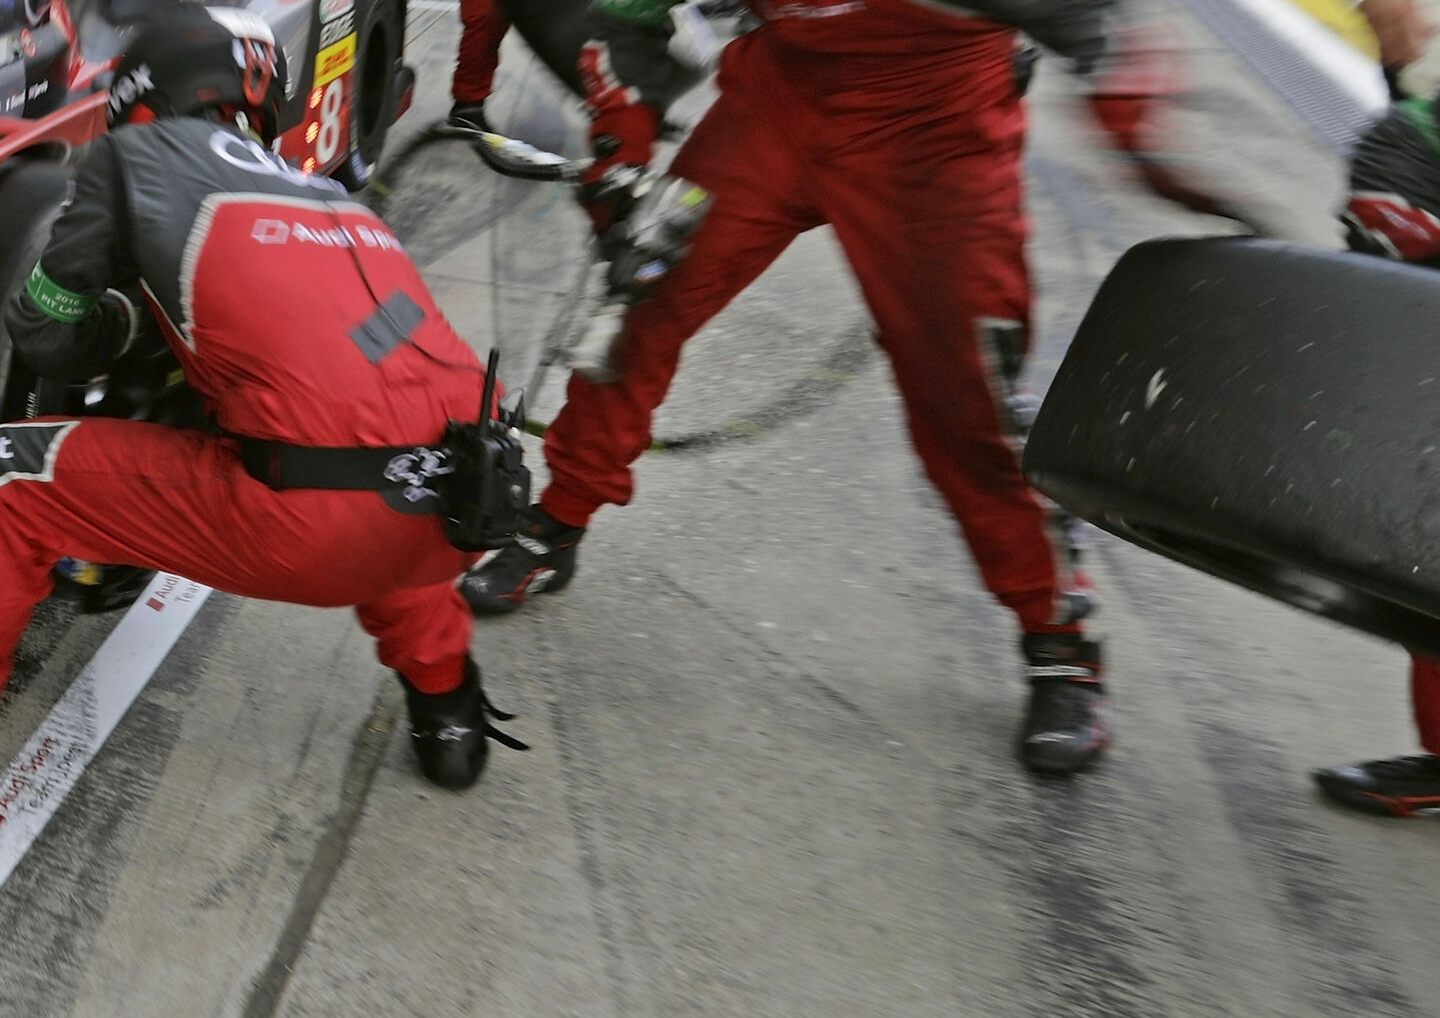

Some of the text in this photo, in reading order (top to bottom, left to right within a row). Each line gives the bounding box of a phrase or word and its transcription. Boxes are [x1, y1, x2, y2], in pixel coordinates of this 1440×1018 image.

[315, 78, 343, 165] 8
[292, 221, 357, 248] Audi
[41, 293, 58, 309] PIT
[55, 292, 81, 307] 2016
[154, 574, 181, 599] Audi
[20, 735, 60, 775] Sport
